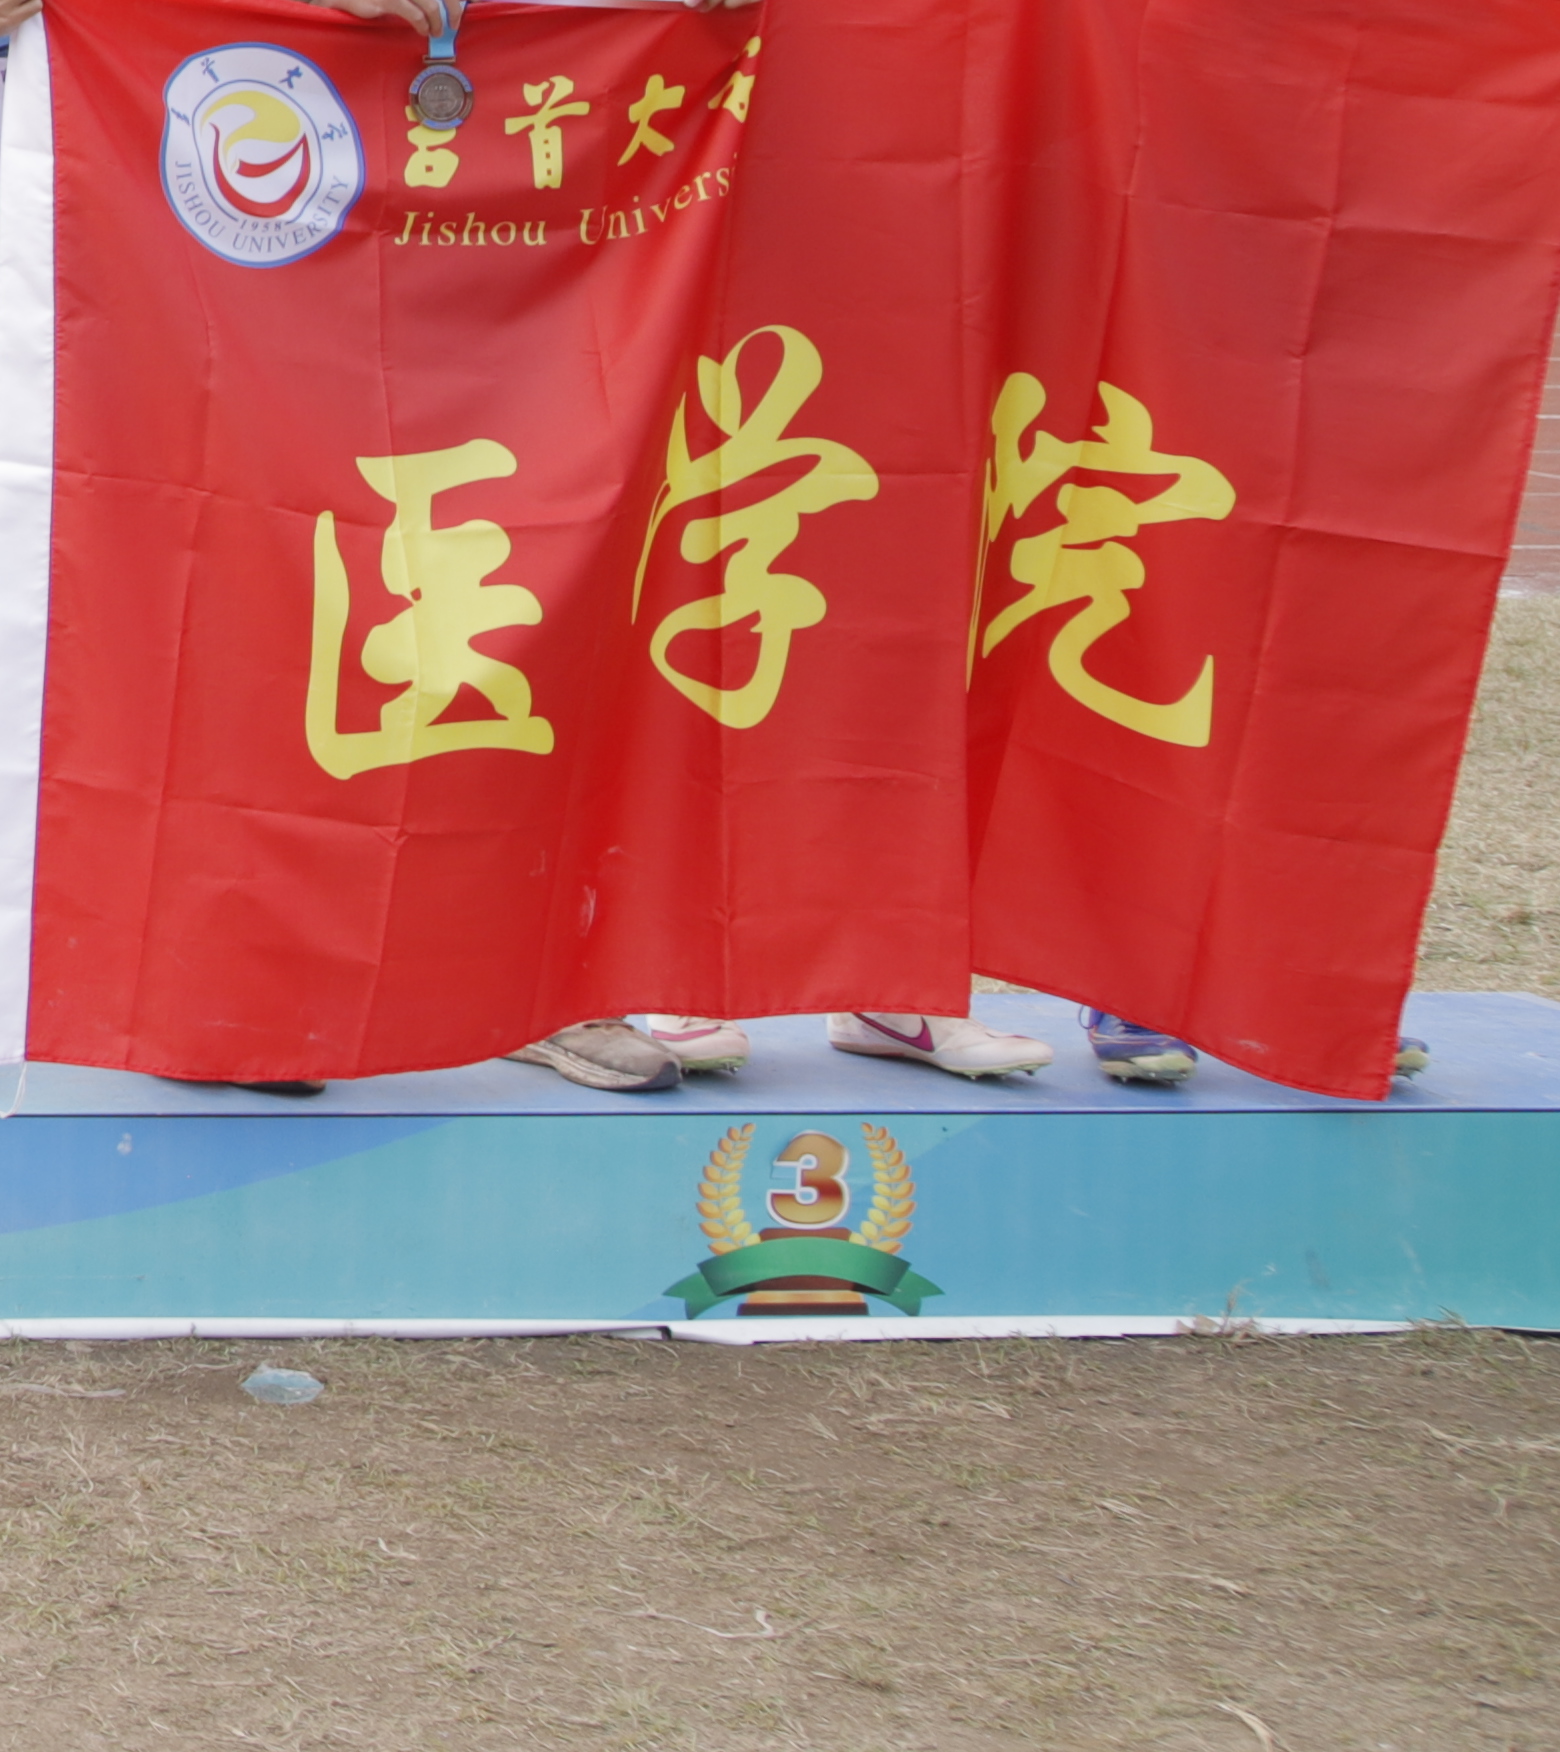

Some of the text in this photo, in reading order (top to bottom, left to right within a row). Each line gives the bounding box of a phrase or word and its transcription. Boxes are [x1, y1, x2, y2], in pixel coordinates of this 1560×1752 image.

[175, 160, 349, 253] JISHOU UNIVERSITY
[240, 220, 282, 232] 1958
[394, 211, 547, 247] Jishou
[306, 324, 1236, 780] 医学院
[766, 1129, 850, 1230] 3
